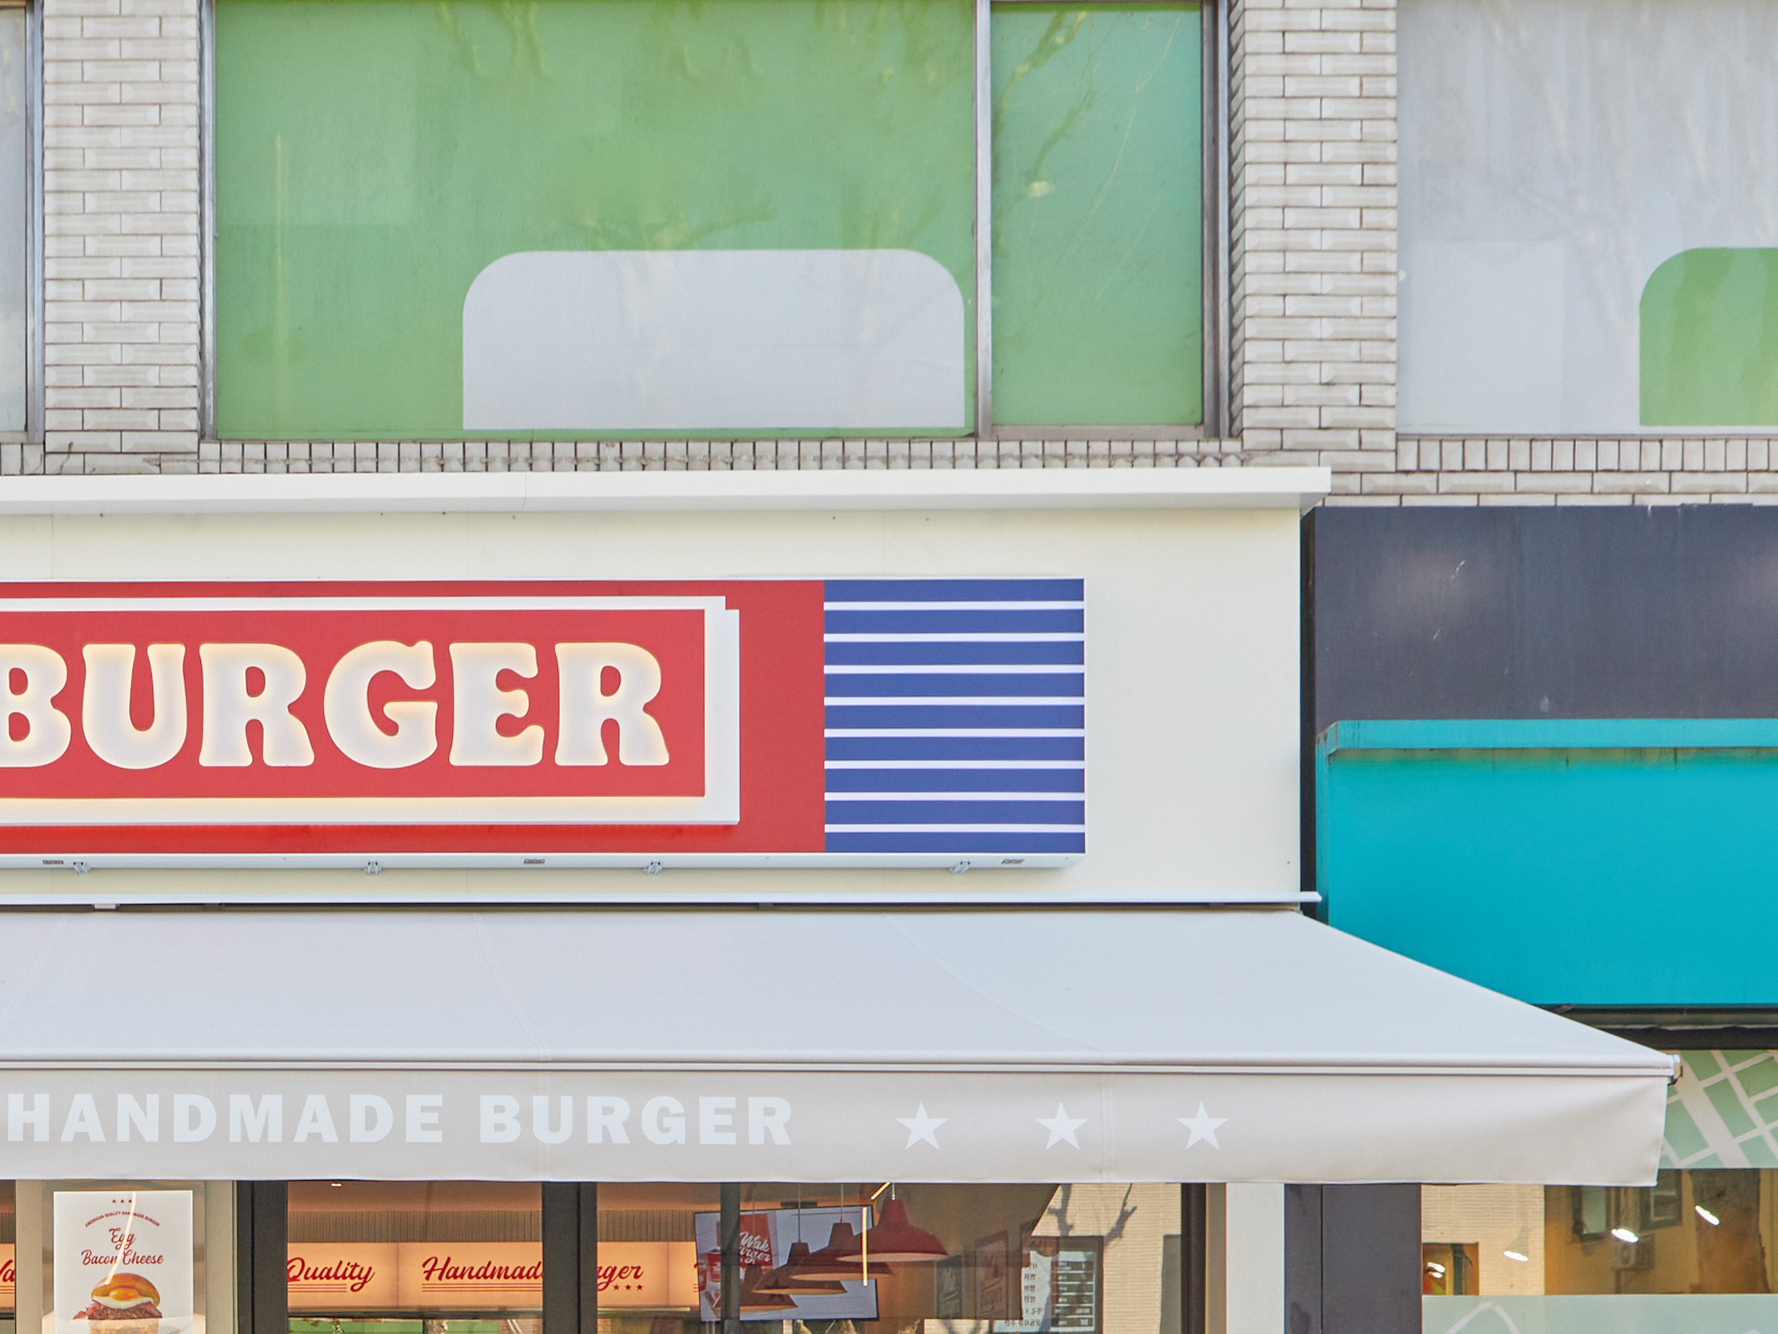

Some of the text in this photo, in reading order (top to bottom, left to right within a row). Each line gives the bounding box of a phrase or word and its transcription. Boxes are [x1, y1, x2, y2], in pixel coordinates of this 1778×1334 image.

[7, 1093, 445, 1145] HANDMADE
[478, 1094, 794, 1145] BURGER
[109, 1228, 136, 1250] Egg
[739, 1230, 771, 1252] Wak
[81, 1249, 164, 1266] Bacon Cheese
[738, 1246, 772, 1264] urger
[287, 1257, 376, 1293] Quality
[421, 1256, 543, 1281] Handmad
